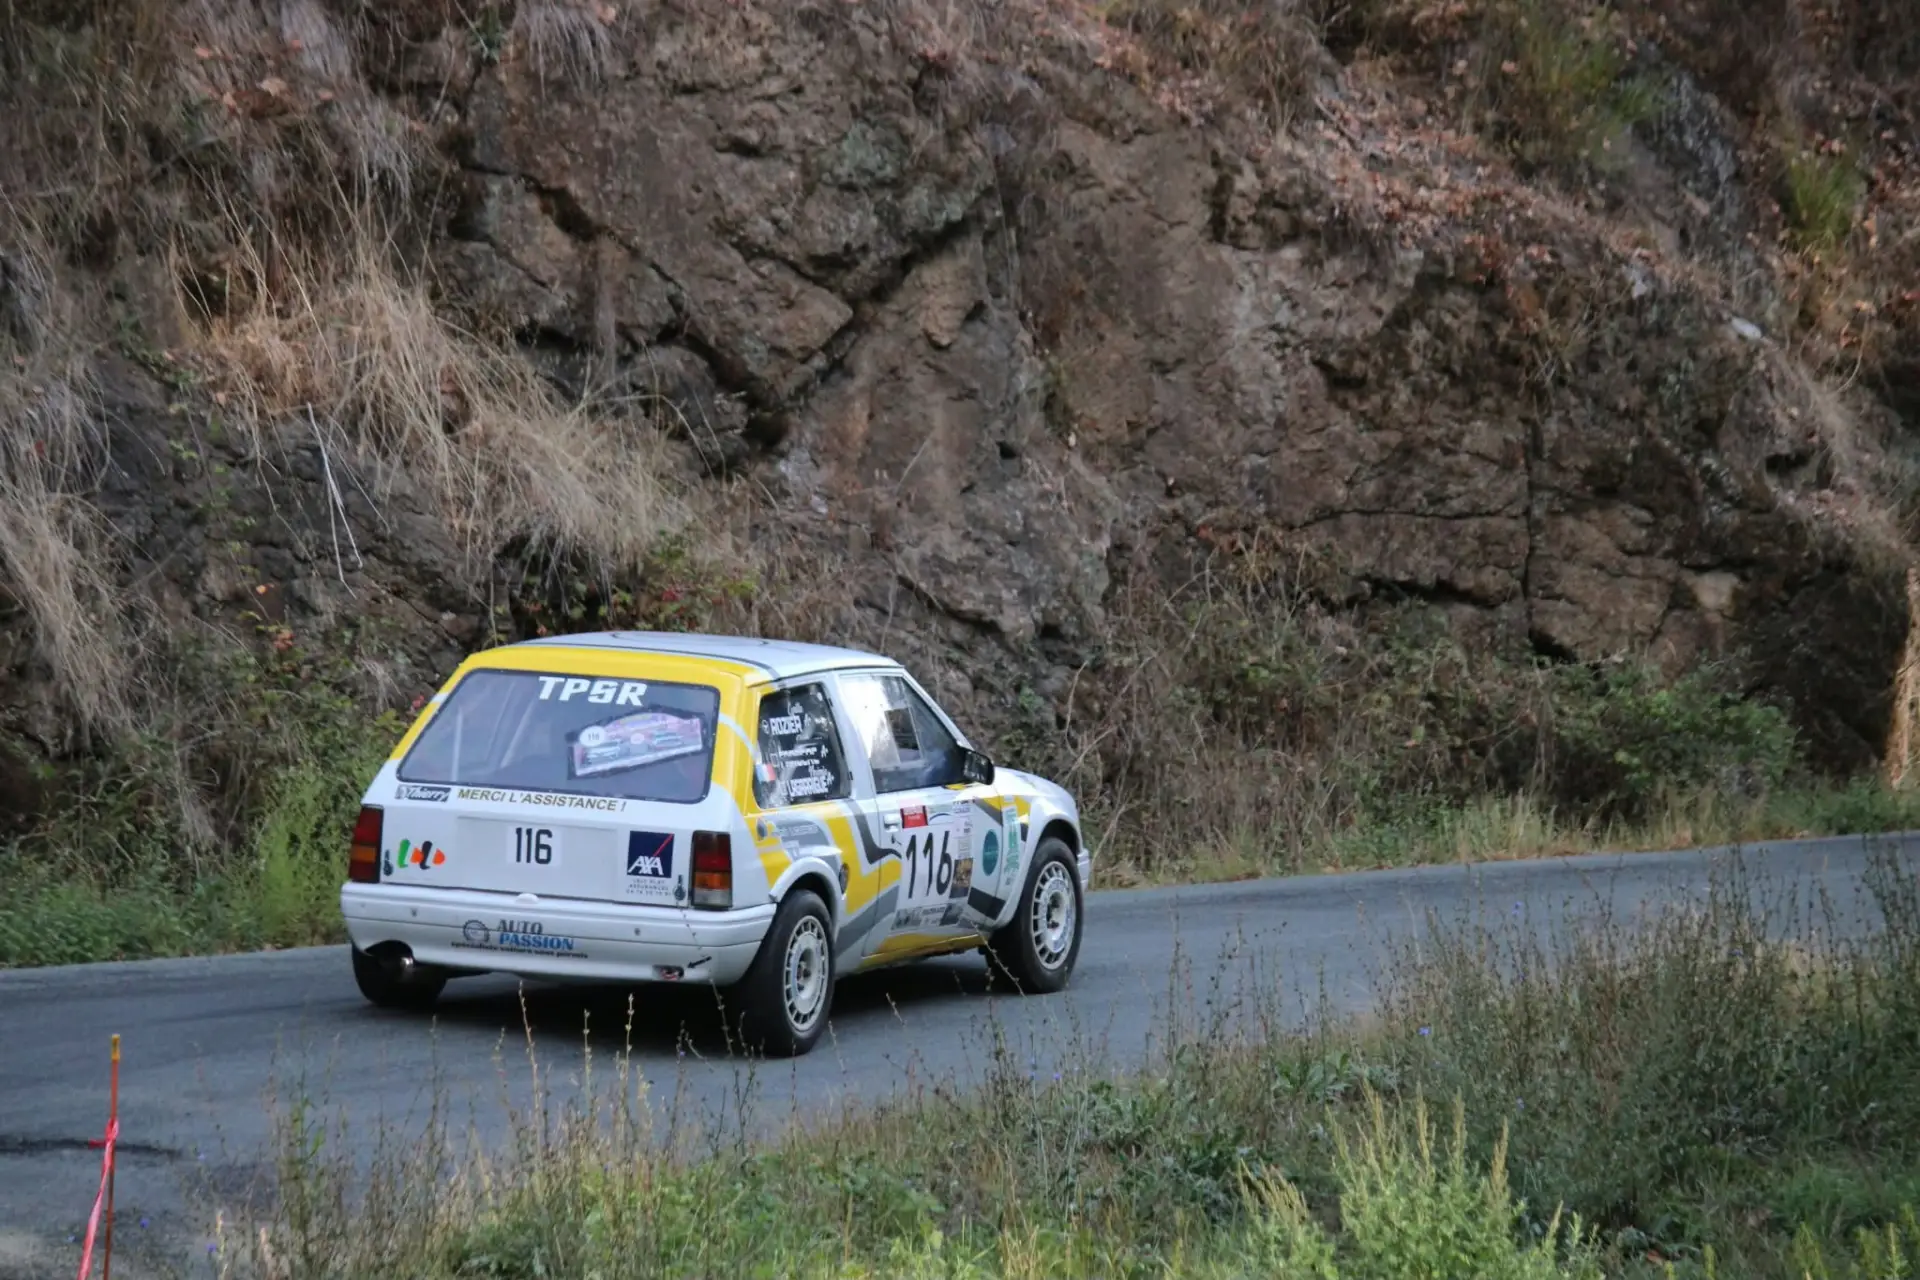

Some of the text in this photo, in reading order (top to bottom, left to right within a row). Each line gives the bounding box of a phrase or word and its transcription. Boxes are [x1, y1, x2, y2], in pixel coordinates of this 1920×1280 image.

[539, 676, 647, 706] TPSR
[406, 786, 449, 802] Thierry
[457, 788, 505, 802] MERCI
[509, 792, 617, 811] L'ASSISTANCE
[515, 826, 553, 865] 116
[627, 855, 664, 876] AXA
[906, 831, 952, 899] 116
[497, 919, 543, 934] AUTO
[499, 932, 574, 950] PASSION
